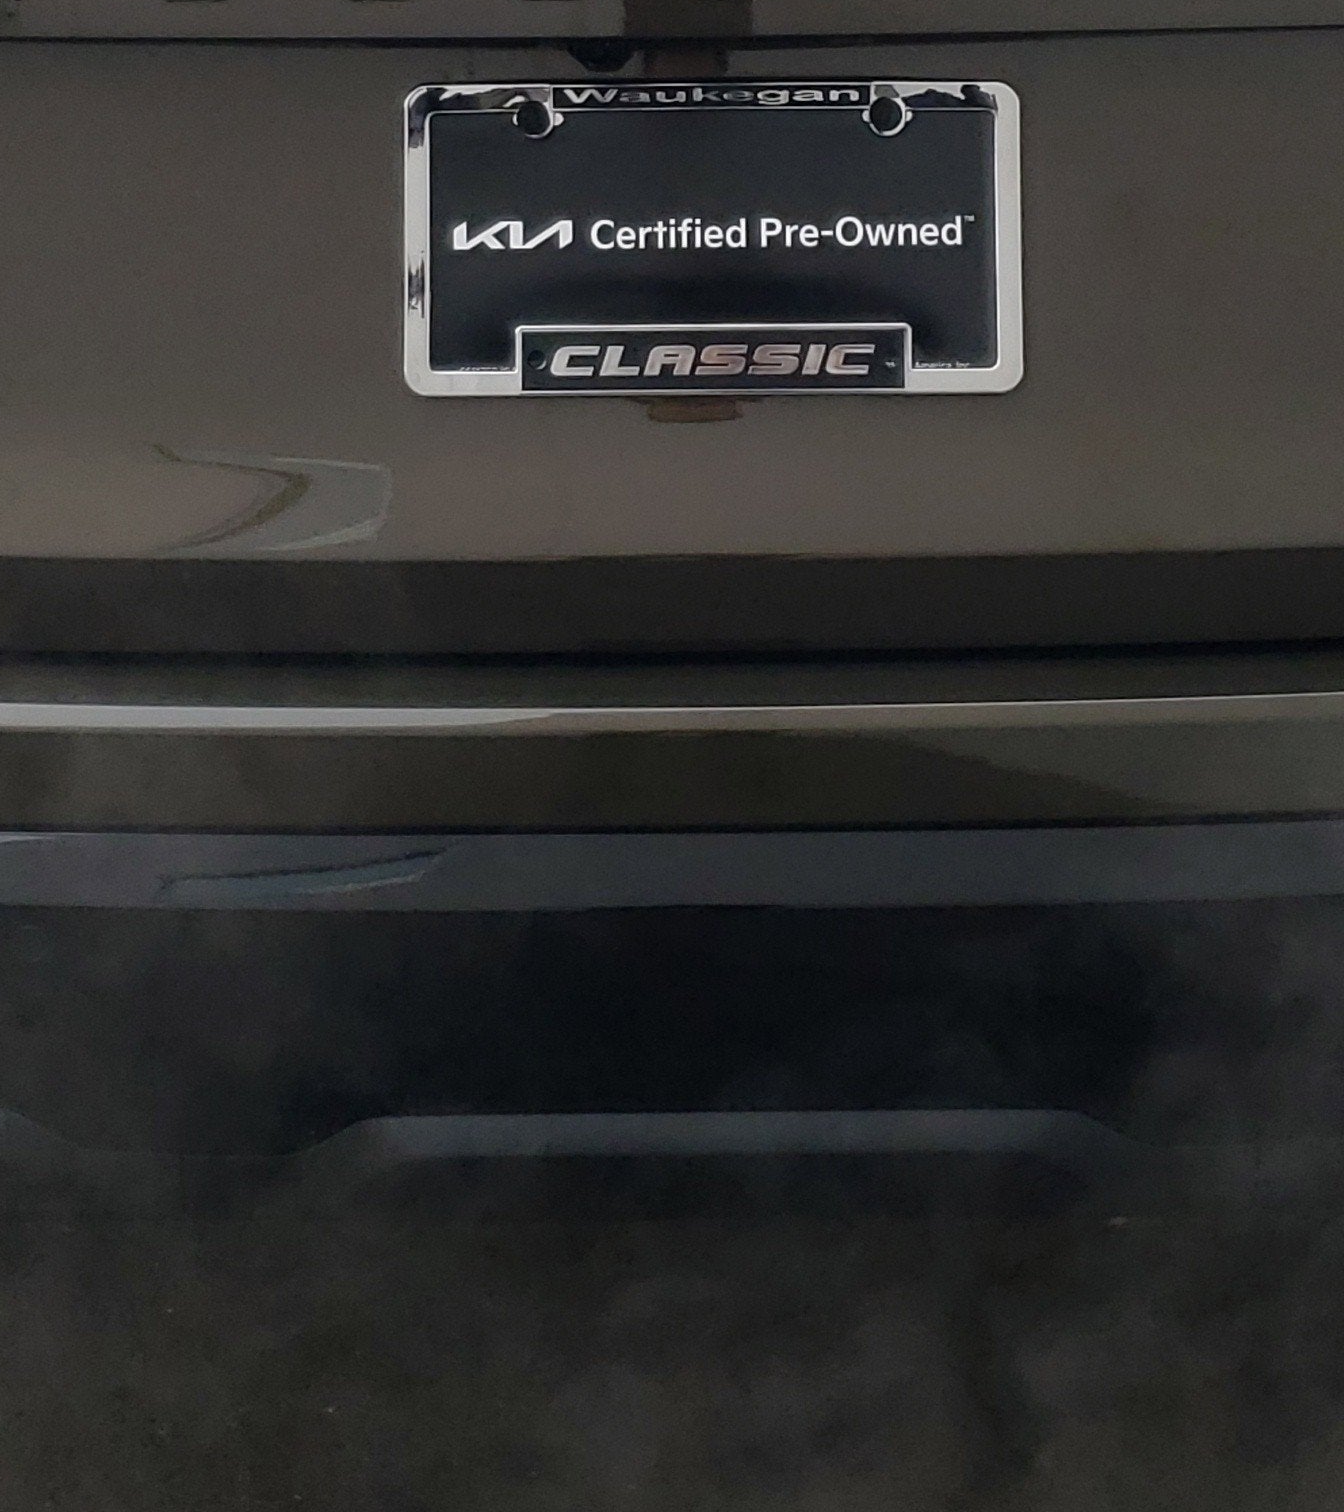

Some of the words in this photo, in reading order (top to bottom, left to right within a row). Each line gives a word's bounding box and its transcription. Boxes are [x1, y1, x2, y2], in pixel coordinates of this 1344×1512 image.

[563, 87, 860, 105] Waukegan
[453, 220, 574, 250] KIA
[590, 217, 747, 249] Certified
[549, 344, 876, 377] CLASSIC
